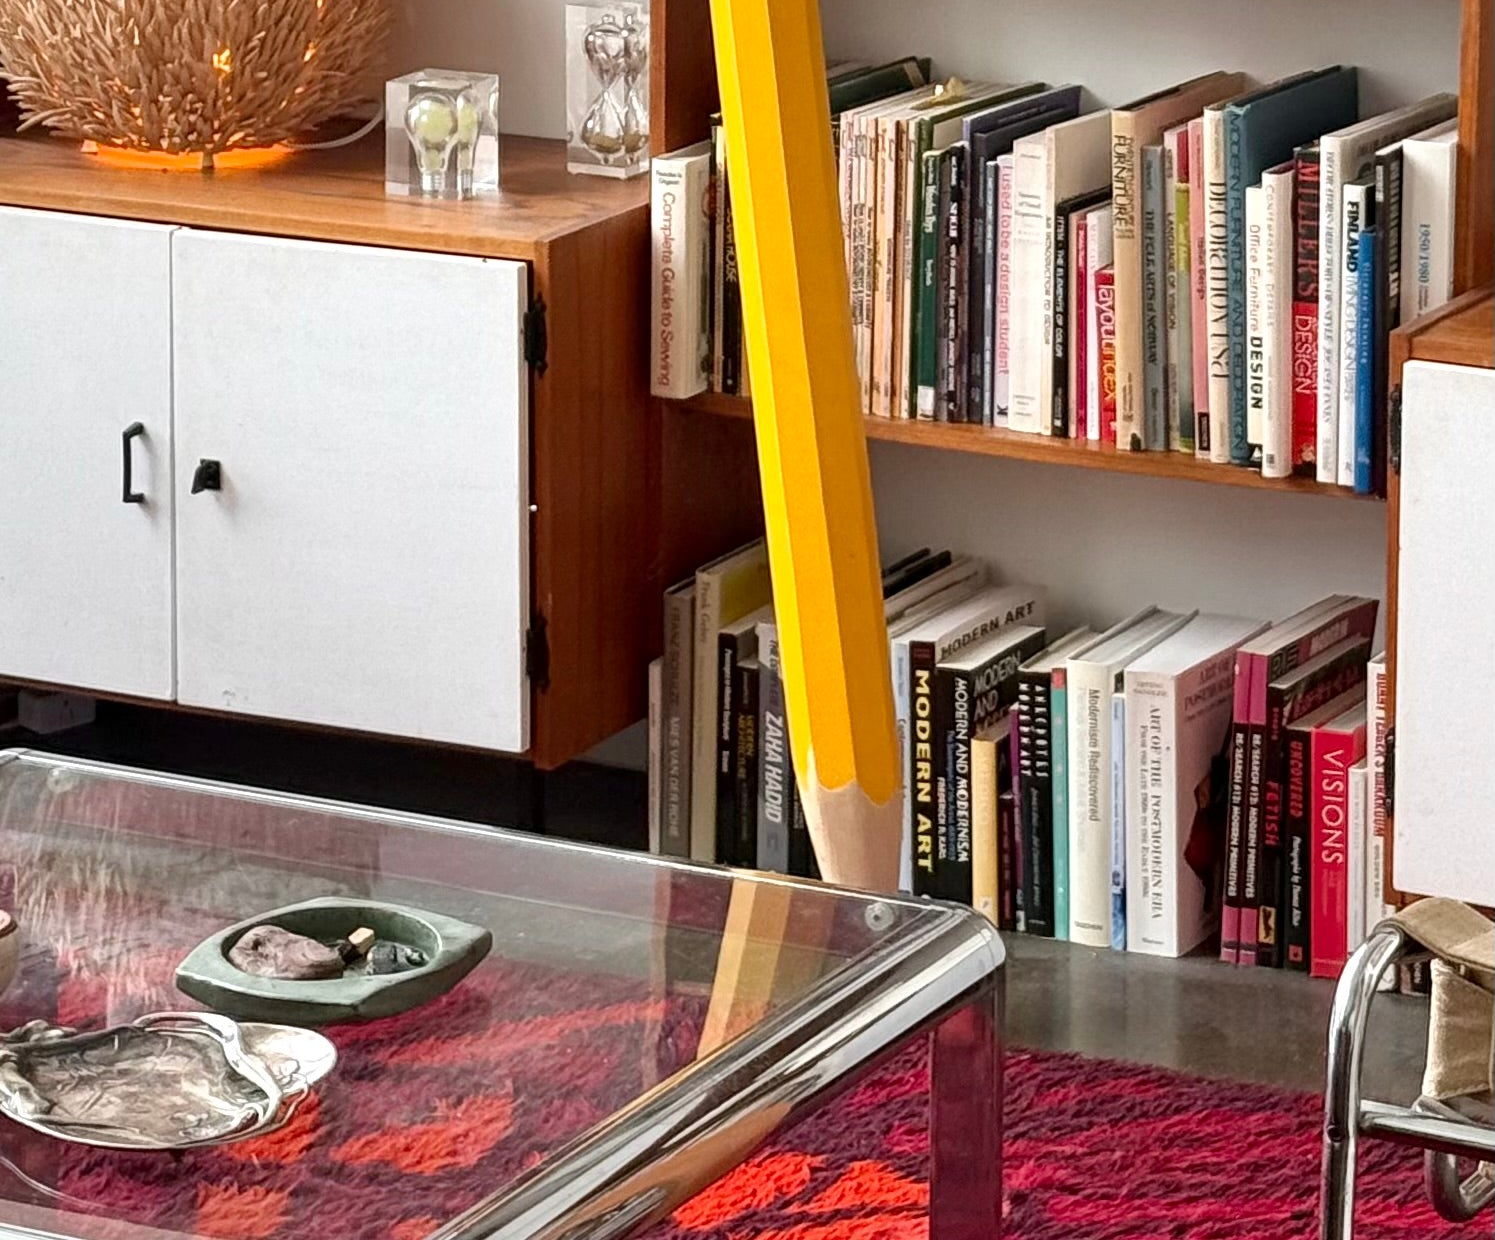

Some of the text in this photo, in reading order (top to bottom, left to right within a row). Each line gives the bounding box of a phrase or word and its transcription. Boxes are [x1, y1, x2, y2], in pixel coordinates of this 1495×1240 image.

[1001, 171, 1012, 209] used
[1113, 135, 1128, 227] FURNITURE
[661, 191, 676, 264] Complete
[1000, 214, 1012, 225] to
[1000, 226, 1011, 248] be
[1145, 208, 1155, 233] THE
[1296, 161, 1319, 297] MILLER'S
[1347, 200, 1360, 272] FINLAND
[1000, 253, 1010, 261] a
[1045, 232, 1053, 296] INTRODUCTION
[1055, 249, 1064, 267] THE
[1145, 236, 1155, 267] FOLK
[1167, 212, 1176, 329] LANGUAGE OF VISION
[1419, 223, 1431, 282] 1950/1980
[662, 267, 676, 310] Guide
[996, 264, 1011, 314] design
[1055, 268, 1064, 311] ELEMENTS
[1146, 271, 1156, 300] ARTS
[1197, 268, 1206, 300] Design
[1229, 114, 1244, 450] MODERN FURNITURE AND DECORATION
[662, 312, 674, 330] to
[1055, 314, 1063, 326] OF
[1147, 315, 1157, 366] NORWAY
[1248, 224, 1262, 409] Office Furniture DESIGN
[1360, 318, 1368, 363] Thinking
[658, 333, 675, 387] Sewing
[998, 318, 1010, 375] student
[1055, 328, 1063, 357] COLOR
[1294, 315, 1312, 394] DESIGN
[941, 600, 1035, 660] MODERN ART
[974, 649, 1021, 698] MODERN
[974, 689, 999, 723] AND
[1018, 683, 1031, 776] MODERN ART
[1034, 684, 1048, 777] ANECDOTES
[669, 716, 680, 837] MIES VAN DER ROHE
[765, 710, 783, 823] ZAHA HADID
[915, 669, 933, 873] MODERN ART
[955, 677, 969, 862] MODERN AND MODERNISM
[1088, 689, 1101, 821] Modernism Rediscovered
[1234, 733, 1244, 783] RE/SEARCH
[1251, 734, 1262, 784] RE/SEARCH
[1289, 741, 1303, 817] UNCOVERED
[1150, 705, 1162, 918] ART OF THE POSTMODERN ERA
[1230, 805, 1241, 845] MODERN
[1248, 807, 1259, 847] MODERN
[1265, 780, 1279, 845] FETISH
[1321, 748, 1344, 864] VISIONS
[1228, 847, 1239, 897] PRIMITIVES
[1245, 848, 1256, 898] PRIMITIVES
